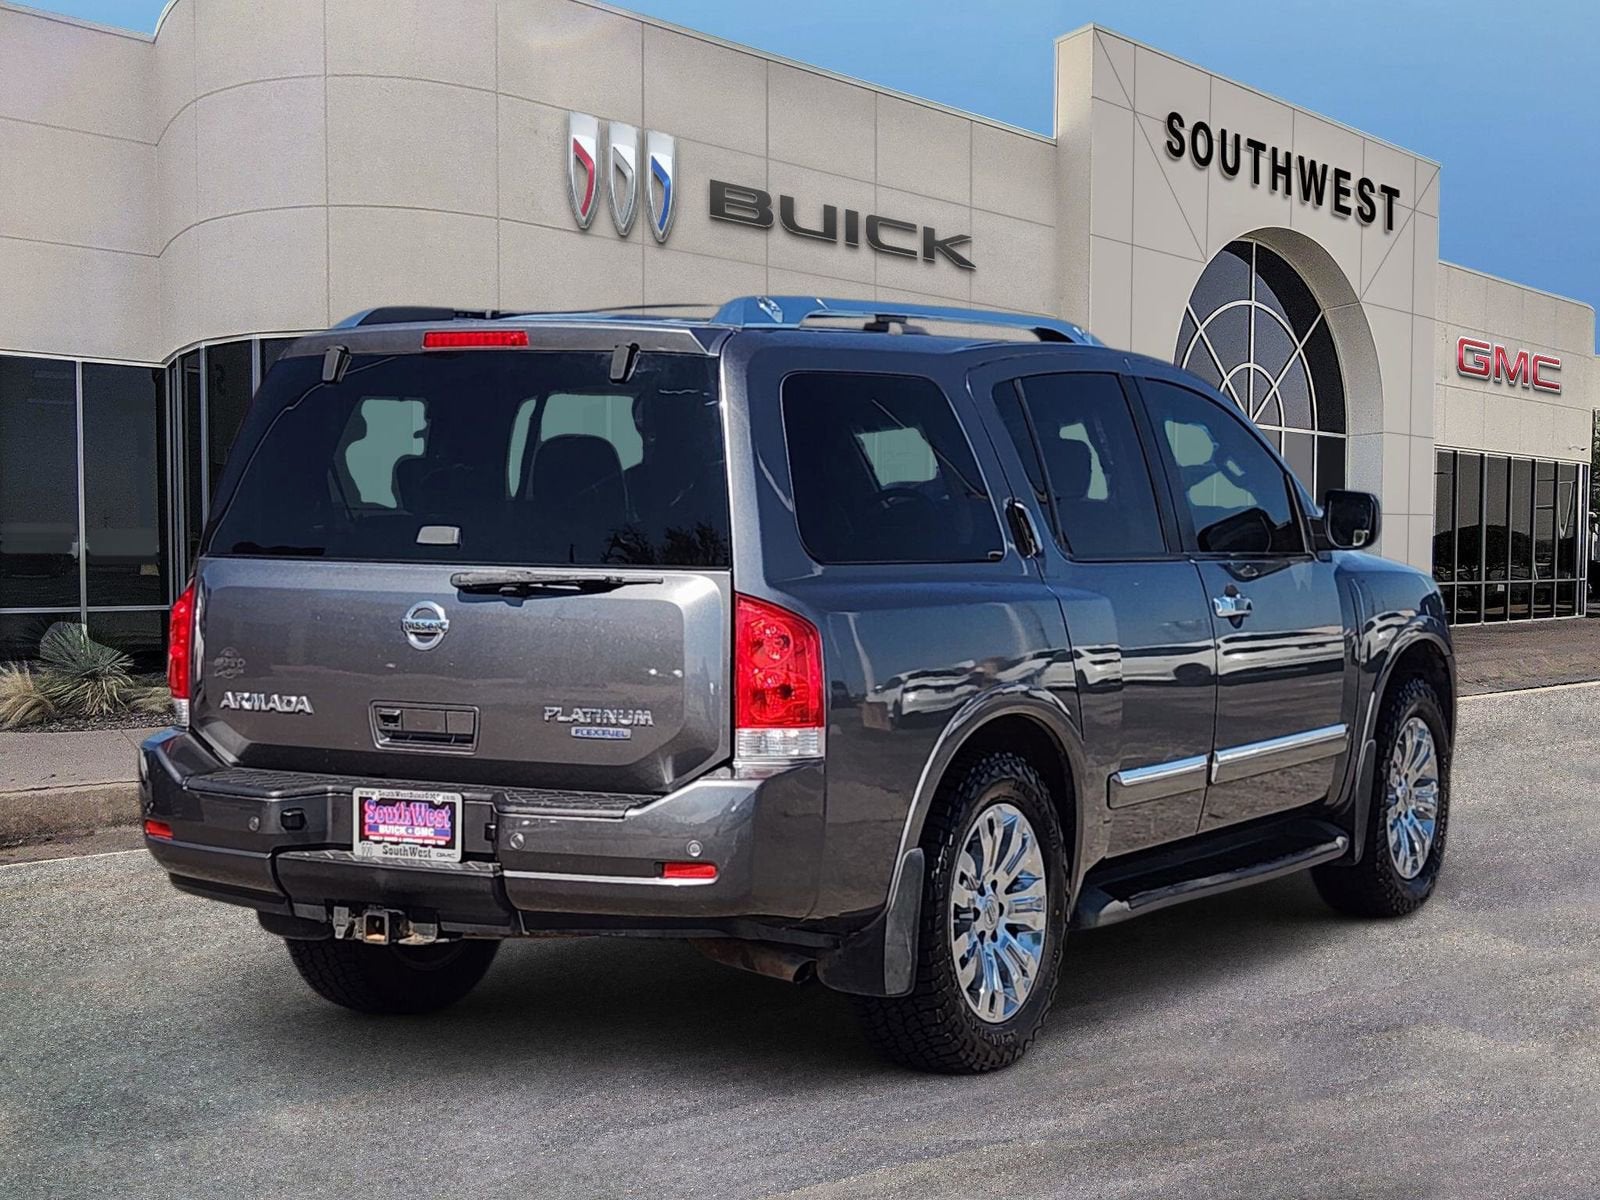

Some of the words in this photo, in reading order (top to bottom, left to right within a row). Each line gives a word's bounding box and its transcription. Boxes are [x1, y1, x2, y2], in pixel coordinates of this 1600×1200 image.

[1166, 112, 1400, 231] SOUTHWEST
[709, 179, 977, 270] BUICK
[1457, 336, 1562, 394] GMC
[405, 620, 447, 632] NISSAN
[220, 691, 314, 714] ARMADA
[544, 706, 654, 726] PLATINUM
[379, 825, 406, 835] BUICK
[414, 827, 434, 836] GMC
